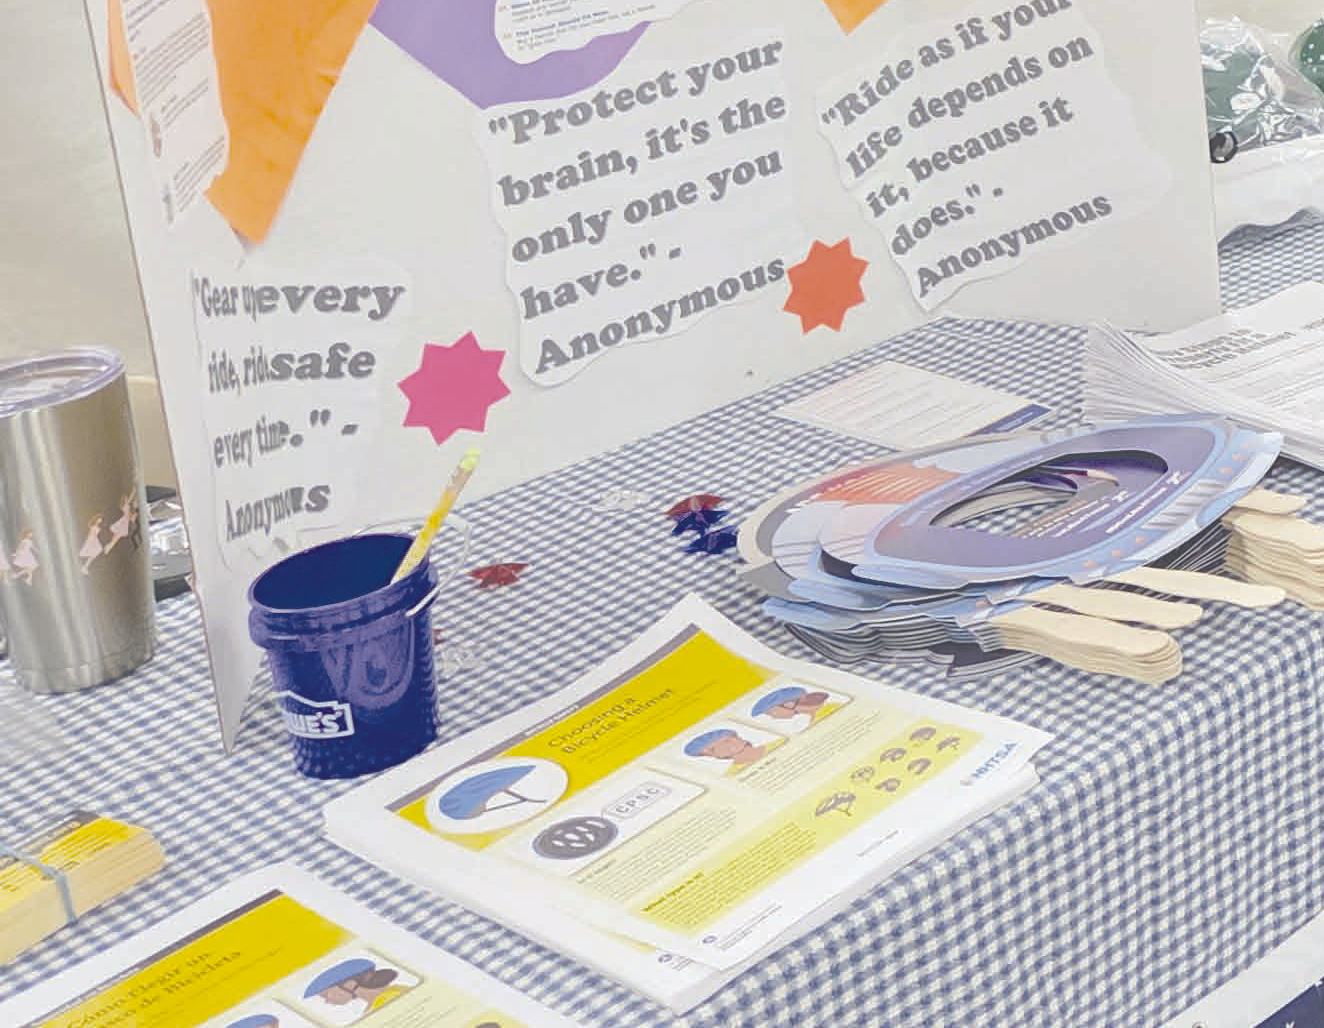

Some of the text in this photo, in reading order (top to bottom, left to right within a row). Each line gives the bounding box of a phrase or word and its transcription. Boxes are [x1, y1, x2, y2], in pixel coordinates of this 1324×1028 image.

[487, 40, 784, 145] "Protect your
[821, 58, 915, 126] "Ride
[918, 37, 956, 69] as
[954, 16, 990, 52] if
[845, 35, 1095, 179] life depends on
[496, 96, 787, 208] brain, it's the
[865, 95, 1075, 219] it, because it
[511, 150, 784, 263] only one you
[916, 194, 1113, 299] Anonymous
[255, 283, 406, 322] every
[520, 243, 658, 320] have."
[535, 257, 786, 376] Anonymous
[269, 342, 377, 381] safe
[213, 425, 254, 469] every
[548, 702, 626, 749] Choosing
[616, 687, 674, 722] Helmet
